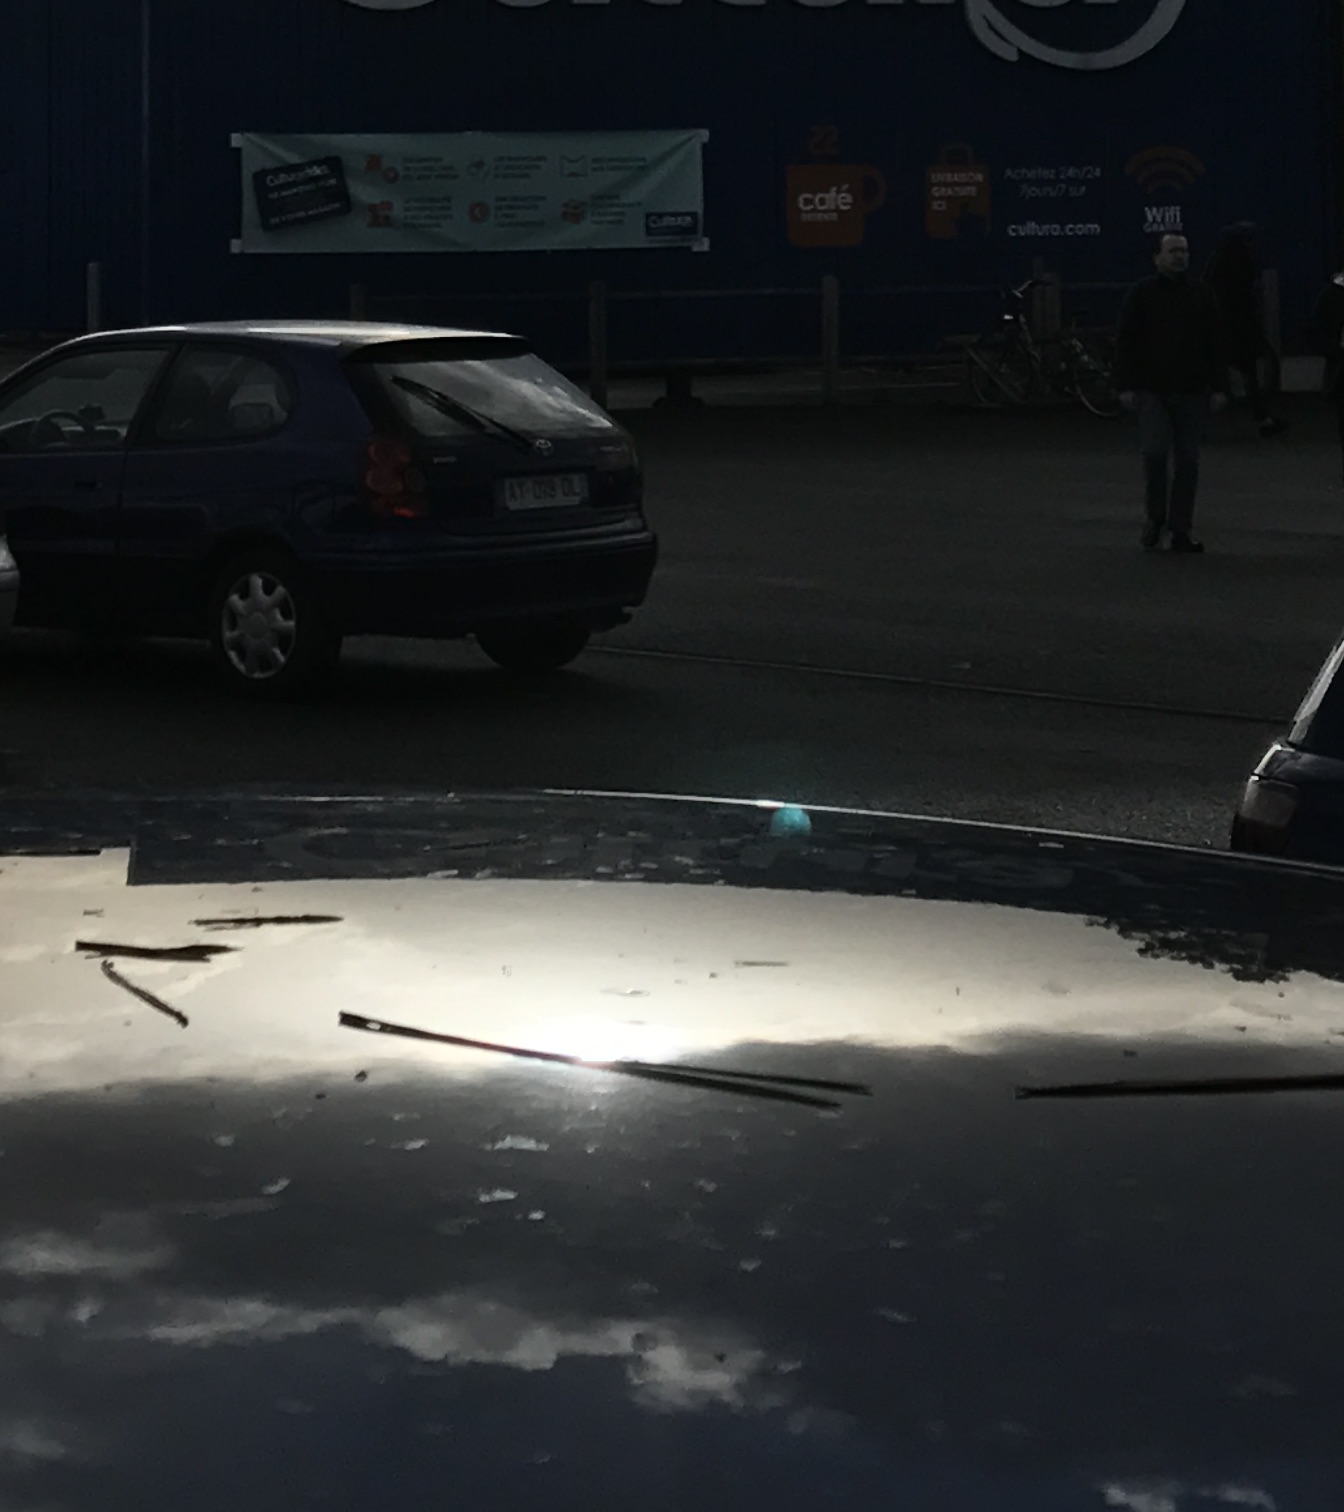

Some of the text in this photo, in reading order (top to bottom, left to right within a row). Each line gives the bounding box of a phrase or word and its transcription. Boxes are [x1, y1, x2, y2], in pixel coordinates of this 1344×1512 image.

[1003, 165, 1102, 180] Achetez 24h/24
[796, 184, 854, 211] café
[1144, 205, 1181, 223] Wifi
[1006, 221, 1102, 237] cultura.com
